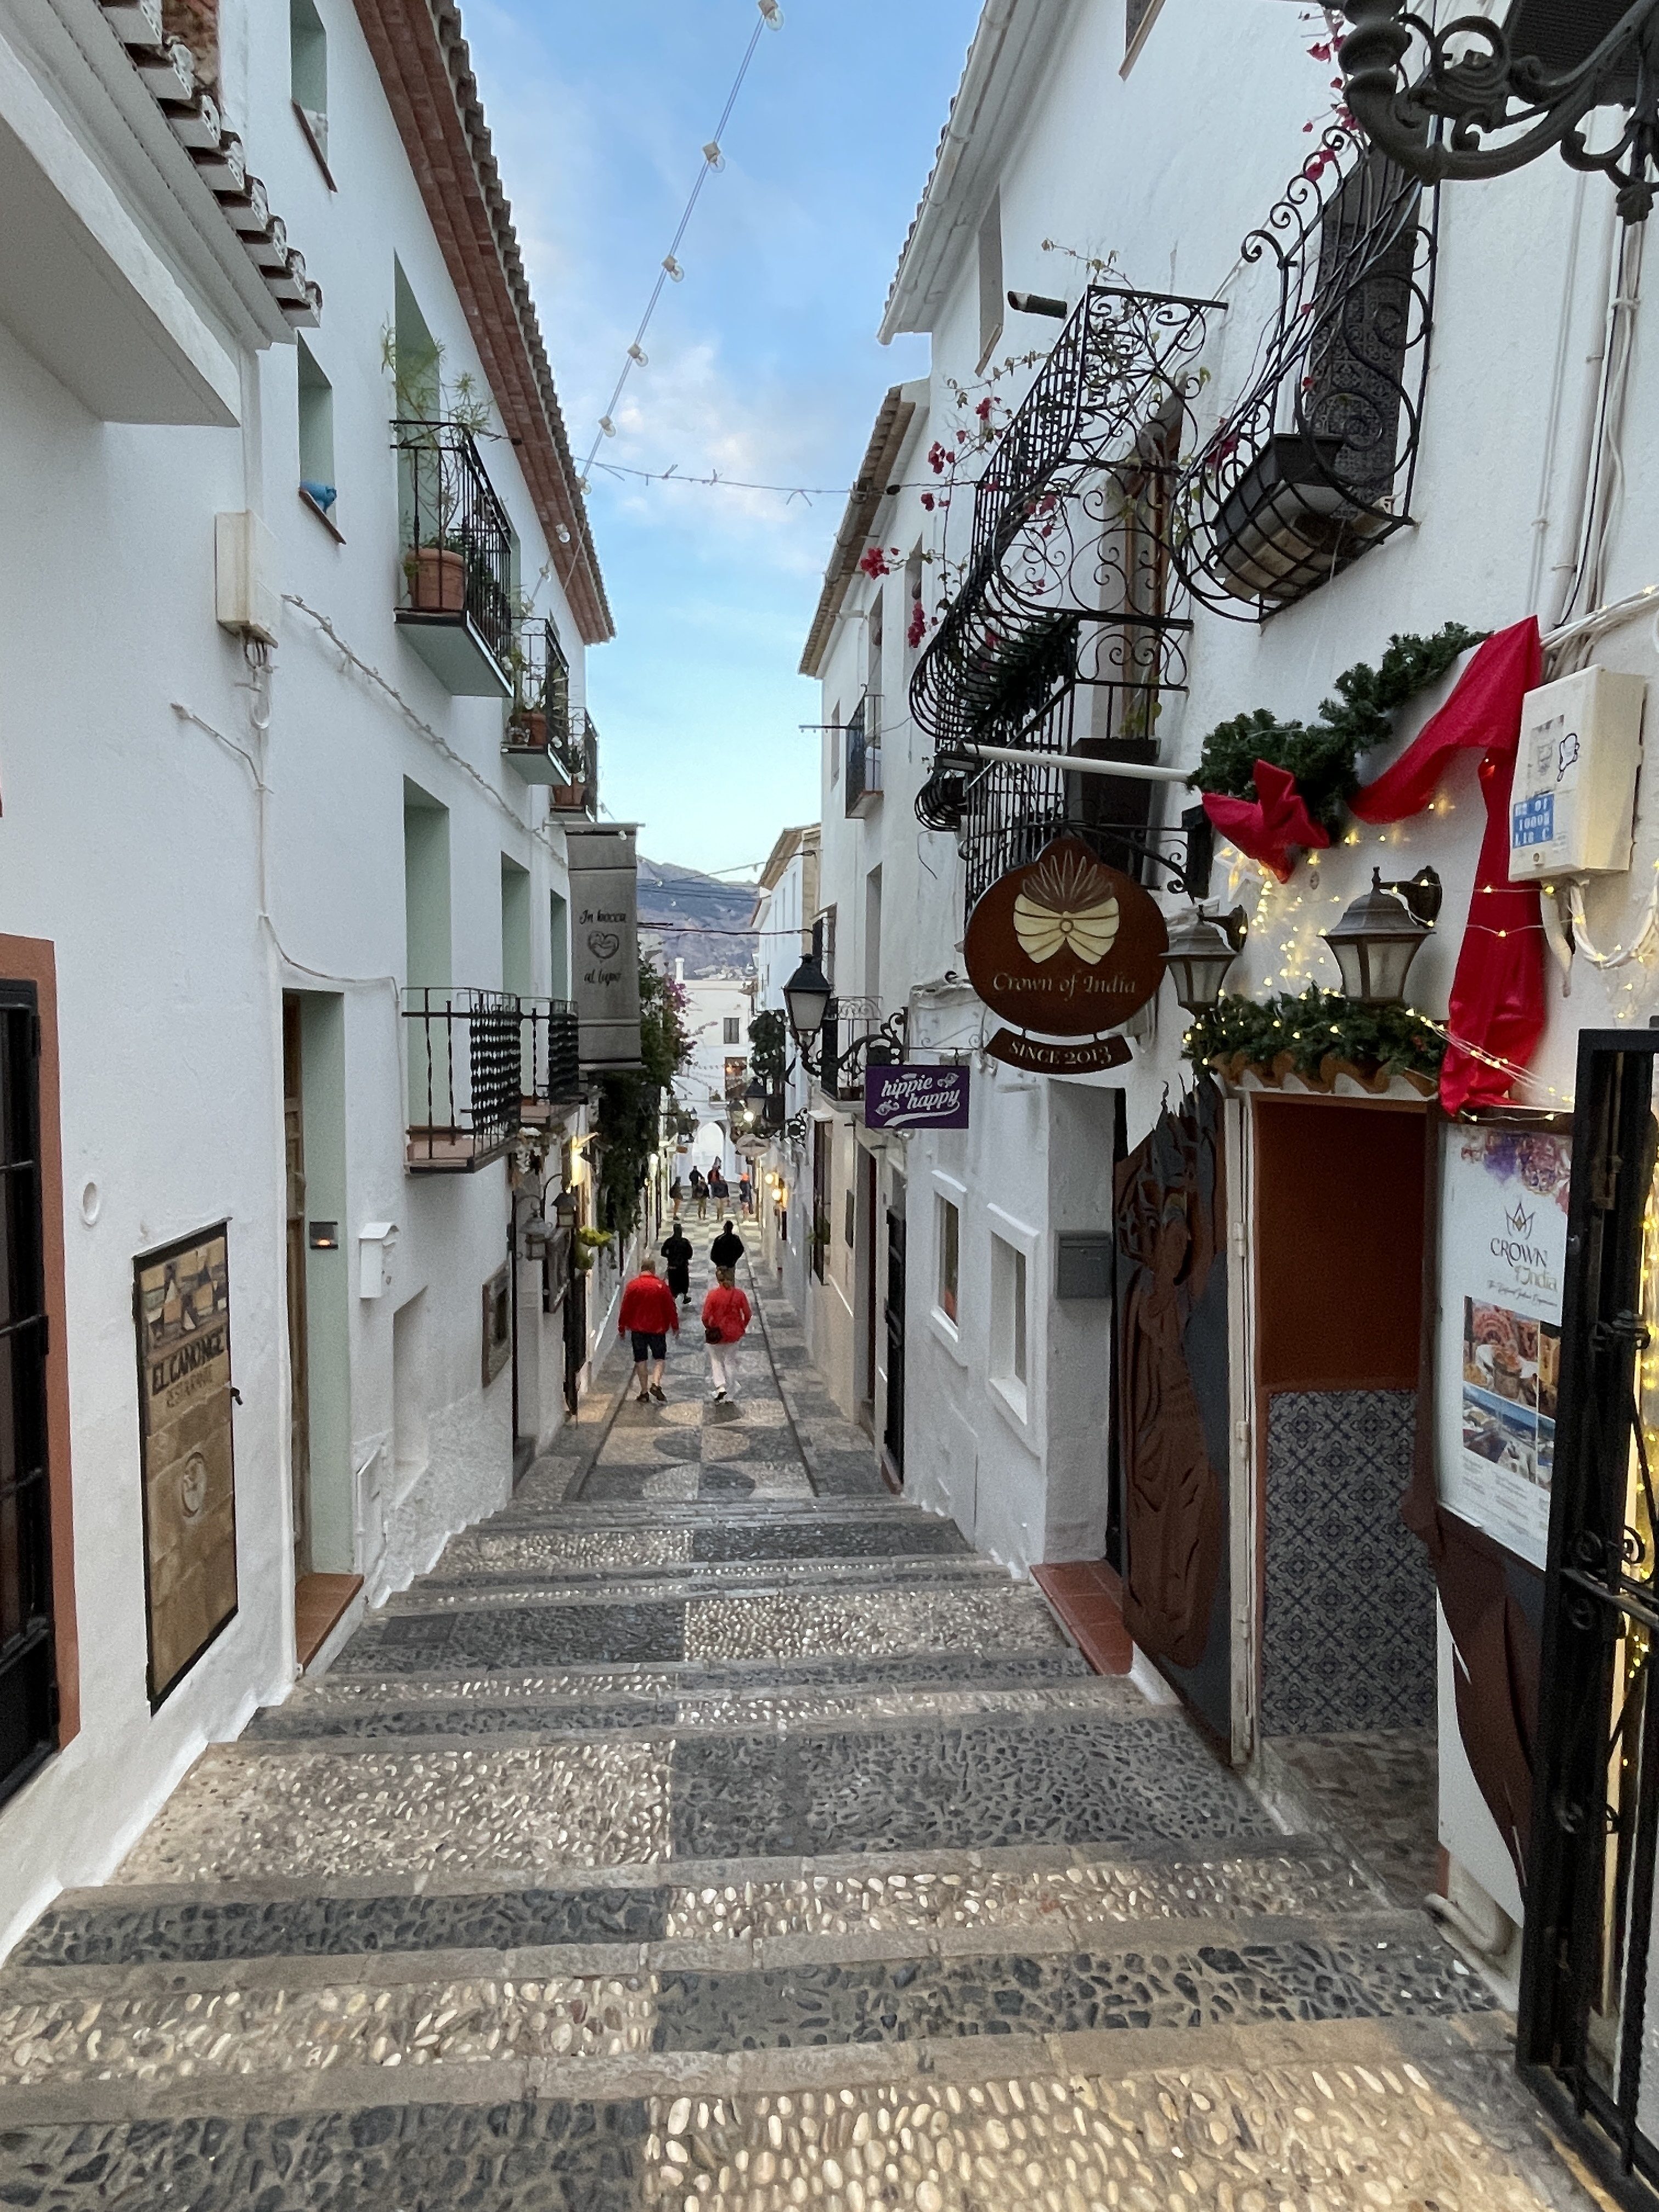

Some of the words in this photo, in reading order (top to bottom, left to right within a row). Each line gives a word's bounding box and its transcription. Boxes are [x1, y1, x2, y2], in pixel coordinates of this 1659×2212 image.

[579, 909, 594, 925] In
[597, 909, 627, 923] bocca
[584, 969, 596, 984] al
[597, 968, 622, 986] lupo
[993, 972, 1052, 991] Crown
[1059, 969, 1081, 1002] of
[1083, 972, 1136, 994] India
[1009, 1040, 1060, 1064] SINCE
[1064, 1045, 1112, 1065] 2013
[881, 1074, 933, 1100] hippie
[907, 1088, 961, 1111] happy
[1490, 1238, 1548, 1268] CROWN
[1521, 1267, 1558, 1292] India
[153, 1361, 170, 1396] EL
